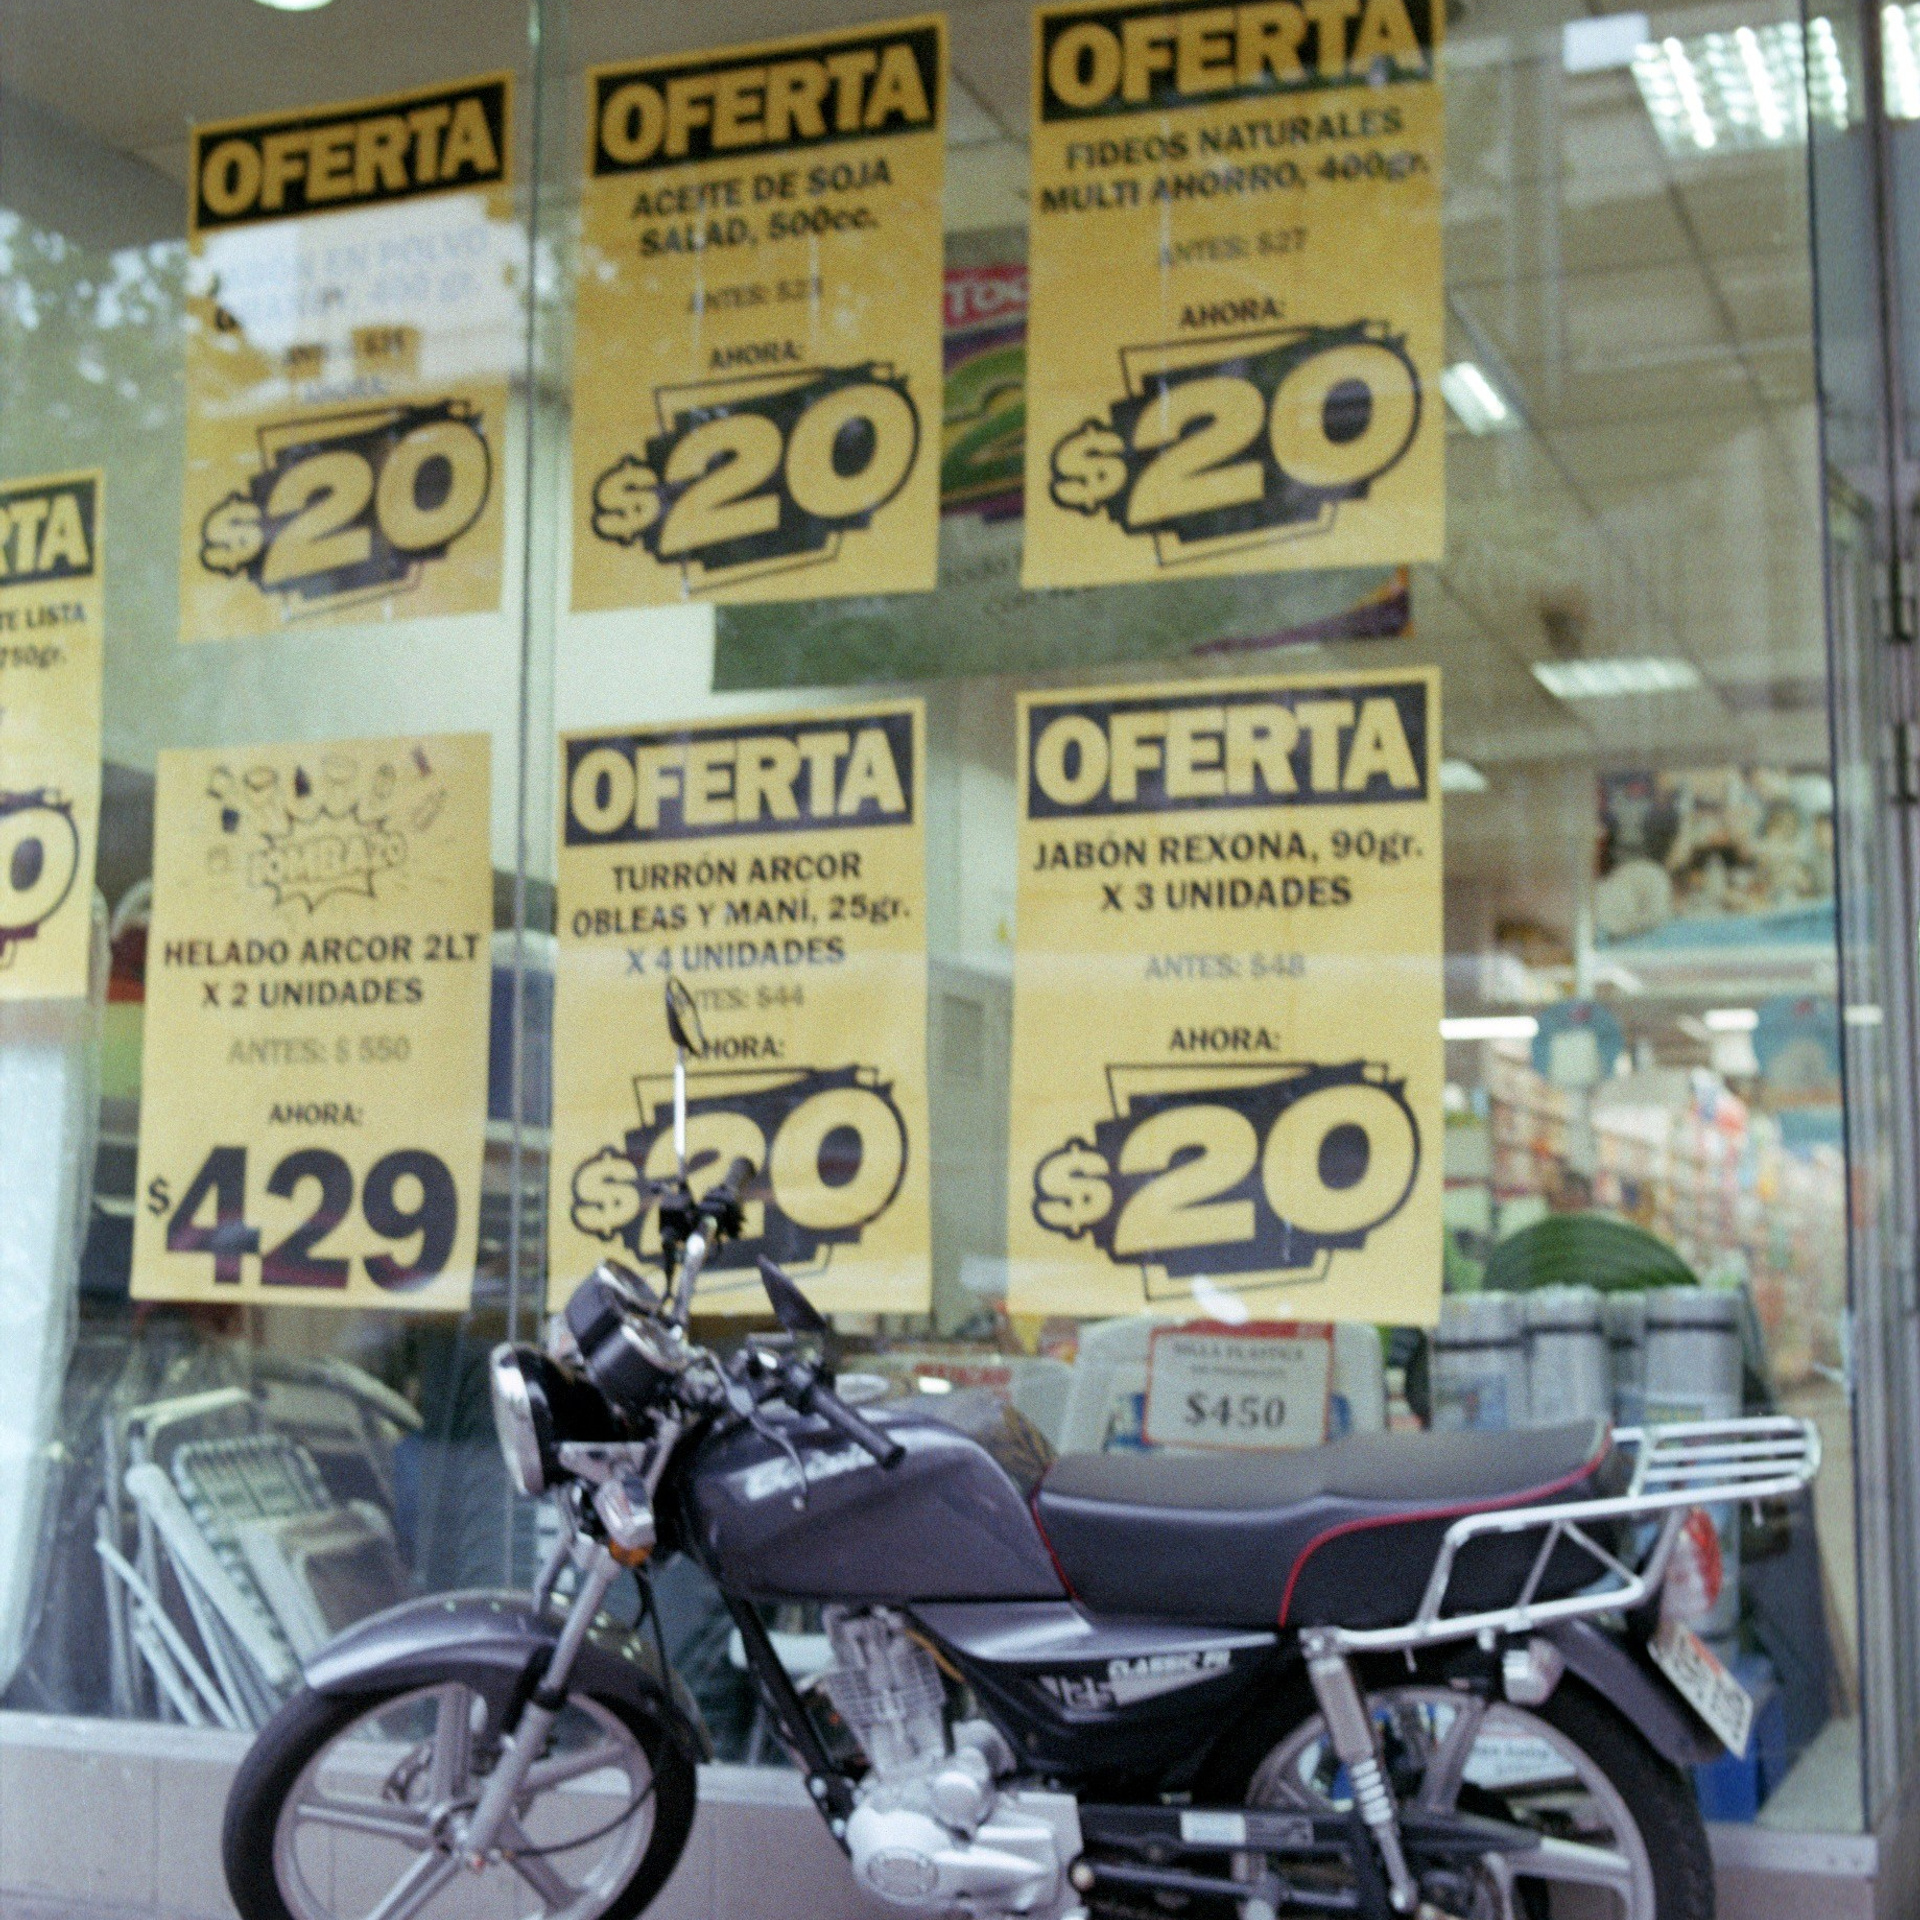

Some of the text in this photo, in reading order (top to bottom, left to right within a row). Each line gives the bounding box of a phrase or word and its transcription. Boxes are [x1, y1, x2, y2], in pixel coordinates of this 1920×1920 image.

[1048, 0, 1418, 109] OFERTA
[600, 43, 930, 165] OFERTA
[202, 98, 499, 217] OFERTA
[1066, 106, 1404, 170] FIDEOS NATURALES
[629, 157, 893, 219] ACEITE DE SOJA
[1041, 178, 1142, 213] MULTI
[1152, 160, 1305, 202] AHORRO,
[637, 204, 882, 260] SALAD, 500cc.
[1178, 298, 1286, 329] AHORA:
[708, 338, 803, 370] AHORA:
[1048, 340, 1422, 536] $20
[593, 382, 920, 558] $20
[202, 415, 489, 588] $20
[0, 493, 89, 576] TA
[1034, 696, 1420, 805] OFERTA
[570, 728, 908, 835] OFERTA
[612, 851, 863, 893] TURRÓN ARCOR
[1032, 830, 1424, 871] JABÓN REXONA, 90gr.
[571, 889, 912, 938] OBLEAS Y MANÍ, 25gr.
[1101, 875, 1354, 911] X 3 UNIDADES
[163, 933, 482, 968] HELADO ARCOR 2LT
[626, 936, 847, 975] X 4 UNIDADES
[1144, 953, 1240, 981] ANTES:
[202, 977, 425, 1008] X 2 UNIDADES
[227, 1037, 328, 1066] ANTES:
[359, 1035, 412, 1063] 550
[1168, 1026, 1280, 1053] AHORA:
[268, 1102, 365, 1127] AHORA:
[572, 1085, 908, 1259] $20
[1034, 1079, 1421, 1255] $20
[1184, 1390, 1287, 1430] $450
